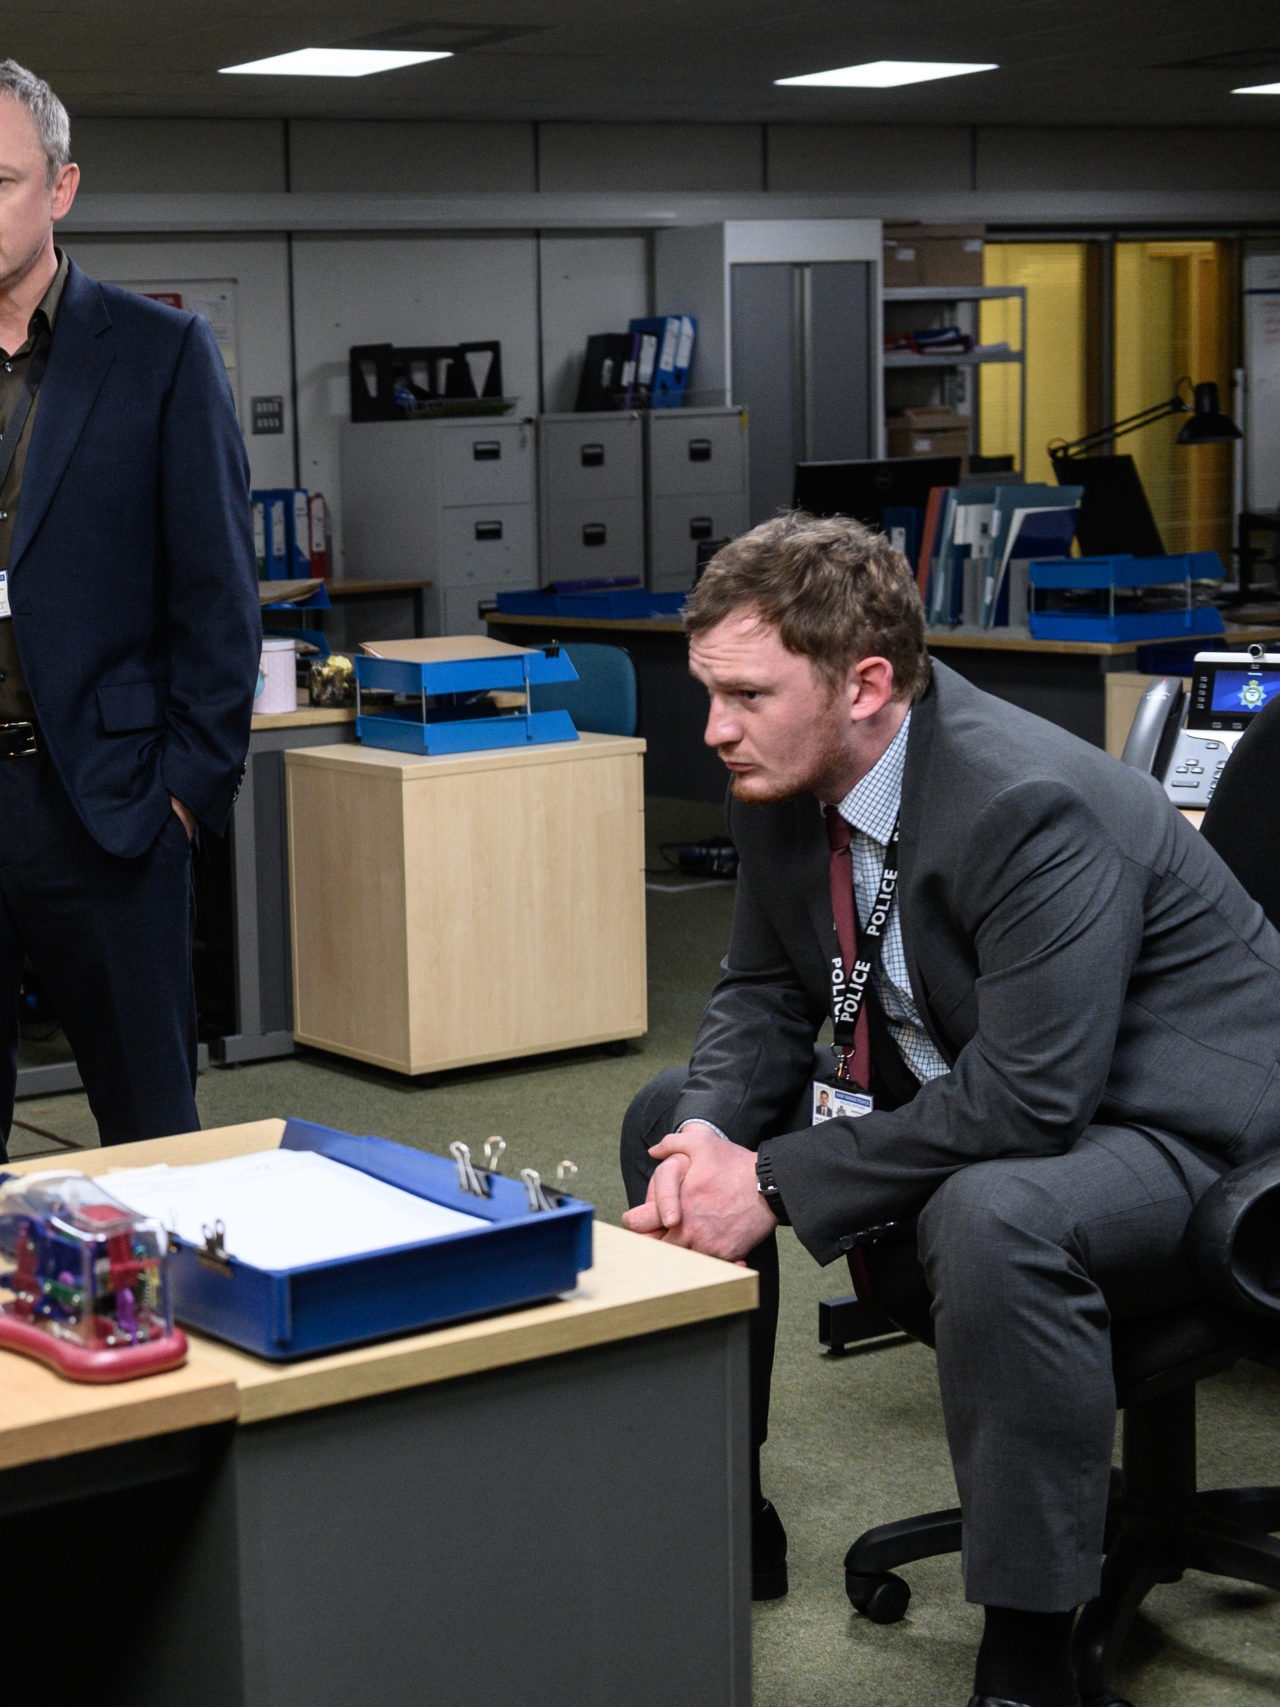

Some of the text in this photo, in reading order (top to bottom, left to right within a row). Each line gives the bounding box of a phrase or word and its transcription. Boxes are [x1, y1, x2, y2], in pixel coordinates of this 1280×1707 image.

[865, 868, 898, 937] POLICE
[831, 957, 846, 1024] POLIC
[839, 960, 871, 1023] POLICE
